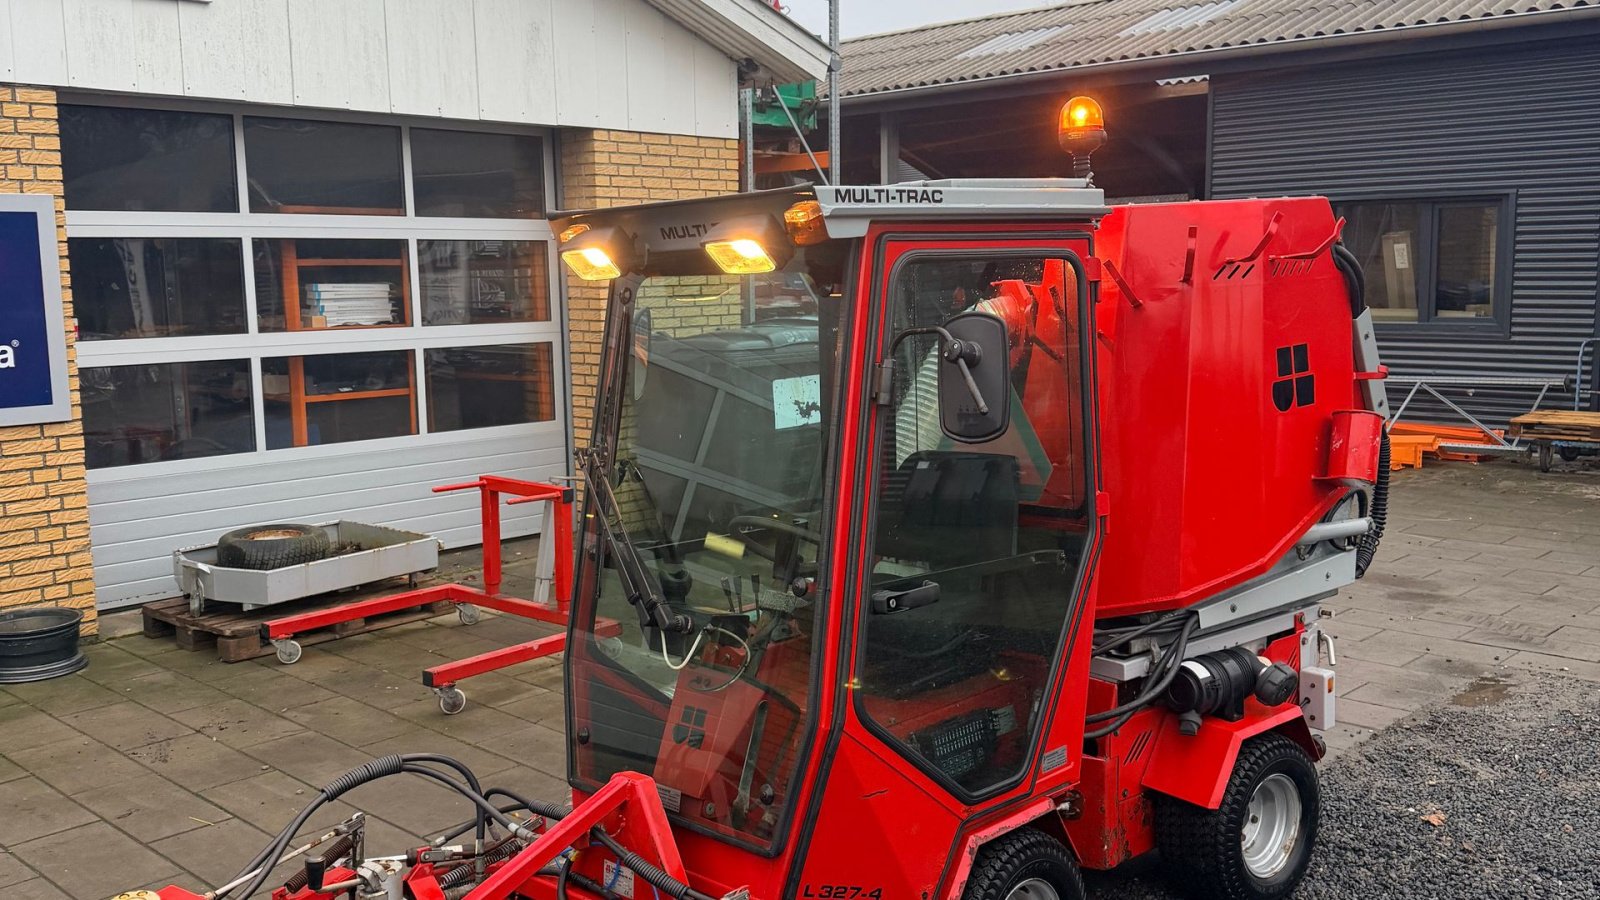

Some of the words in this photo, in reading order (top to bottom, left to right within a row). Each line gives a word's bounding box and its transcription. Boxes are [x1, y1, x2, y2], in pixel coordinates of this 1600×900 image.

[834, 188, 943, 203] MULTI-TRAC
[660, 222, 718, 240] MULTI
[818, 885, 882, 900] 327-4
